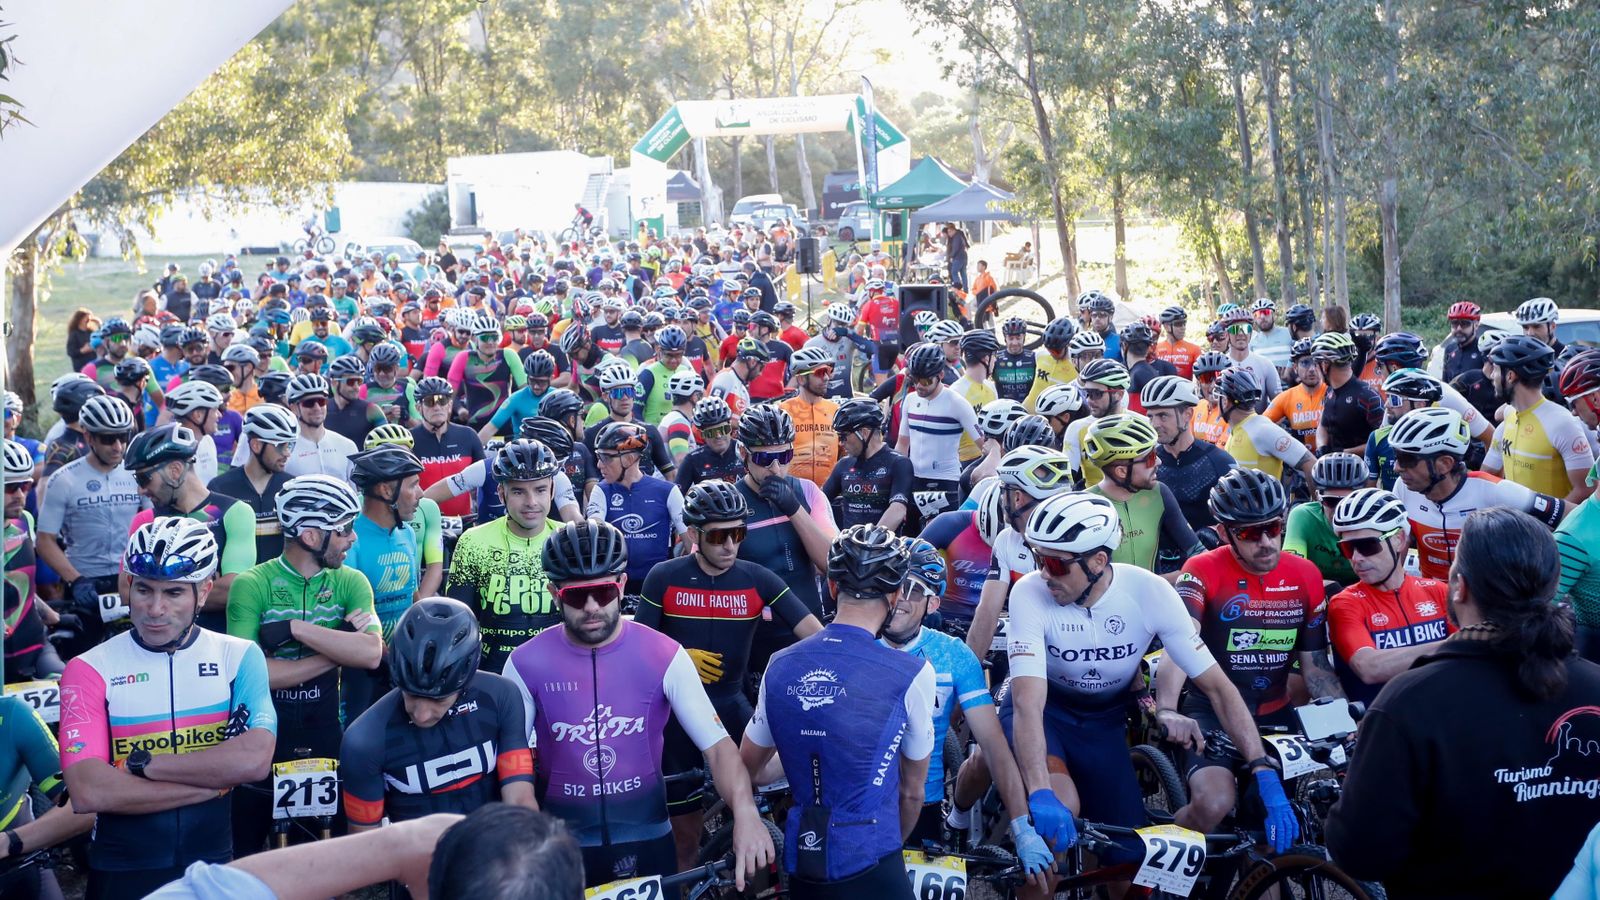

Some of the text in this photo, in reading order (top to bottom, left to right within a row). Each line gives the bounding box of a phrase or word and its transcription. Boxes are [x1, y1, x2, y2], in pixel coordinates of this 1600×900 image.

[795, 424, 819, 432] OCURA
[1424, 438, 1450, 448] SCOTT
[676, 591, 747, 609] CONIL RACING
[730, 608, 748, 616] TEAM
[1257, 634, 1294, 647] koala
[1375, 620, 1446, 650] FALI BIKE
[1048, 643, 1138, 662] COTREL
[1230, 653, 1289, 664] SENA E HIJOS
[198, 663, 219, 676] ES
[583, 703, 612, 723] LA
[66, 729, 80, 739] 12
[552, 716, 645, 745] TRUFA
[812, 759, 821, 805] CEUTA
[1494, 766, 1553, 783] Turismo
[276, 776, 337, 808] 213
[564, 776, 642, 797] 512 BIKES
[1146, 838, 1206, 878] 279
